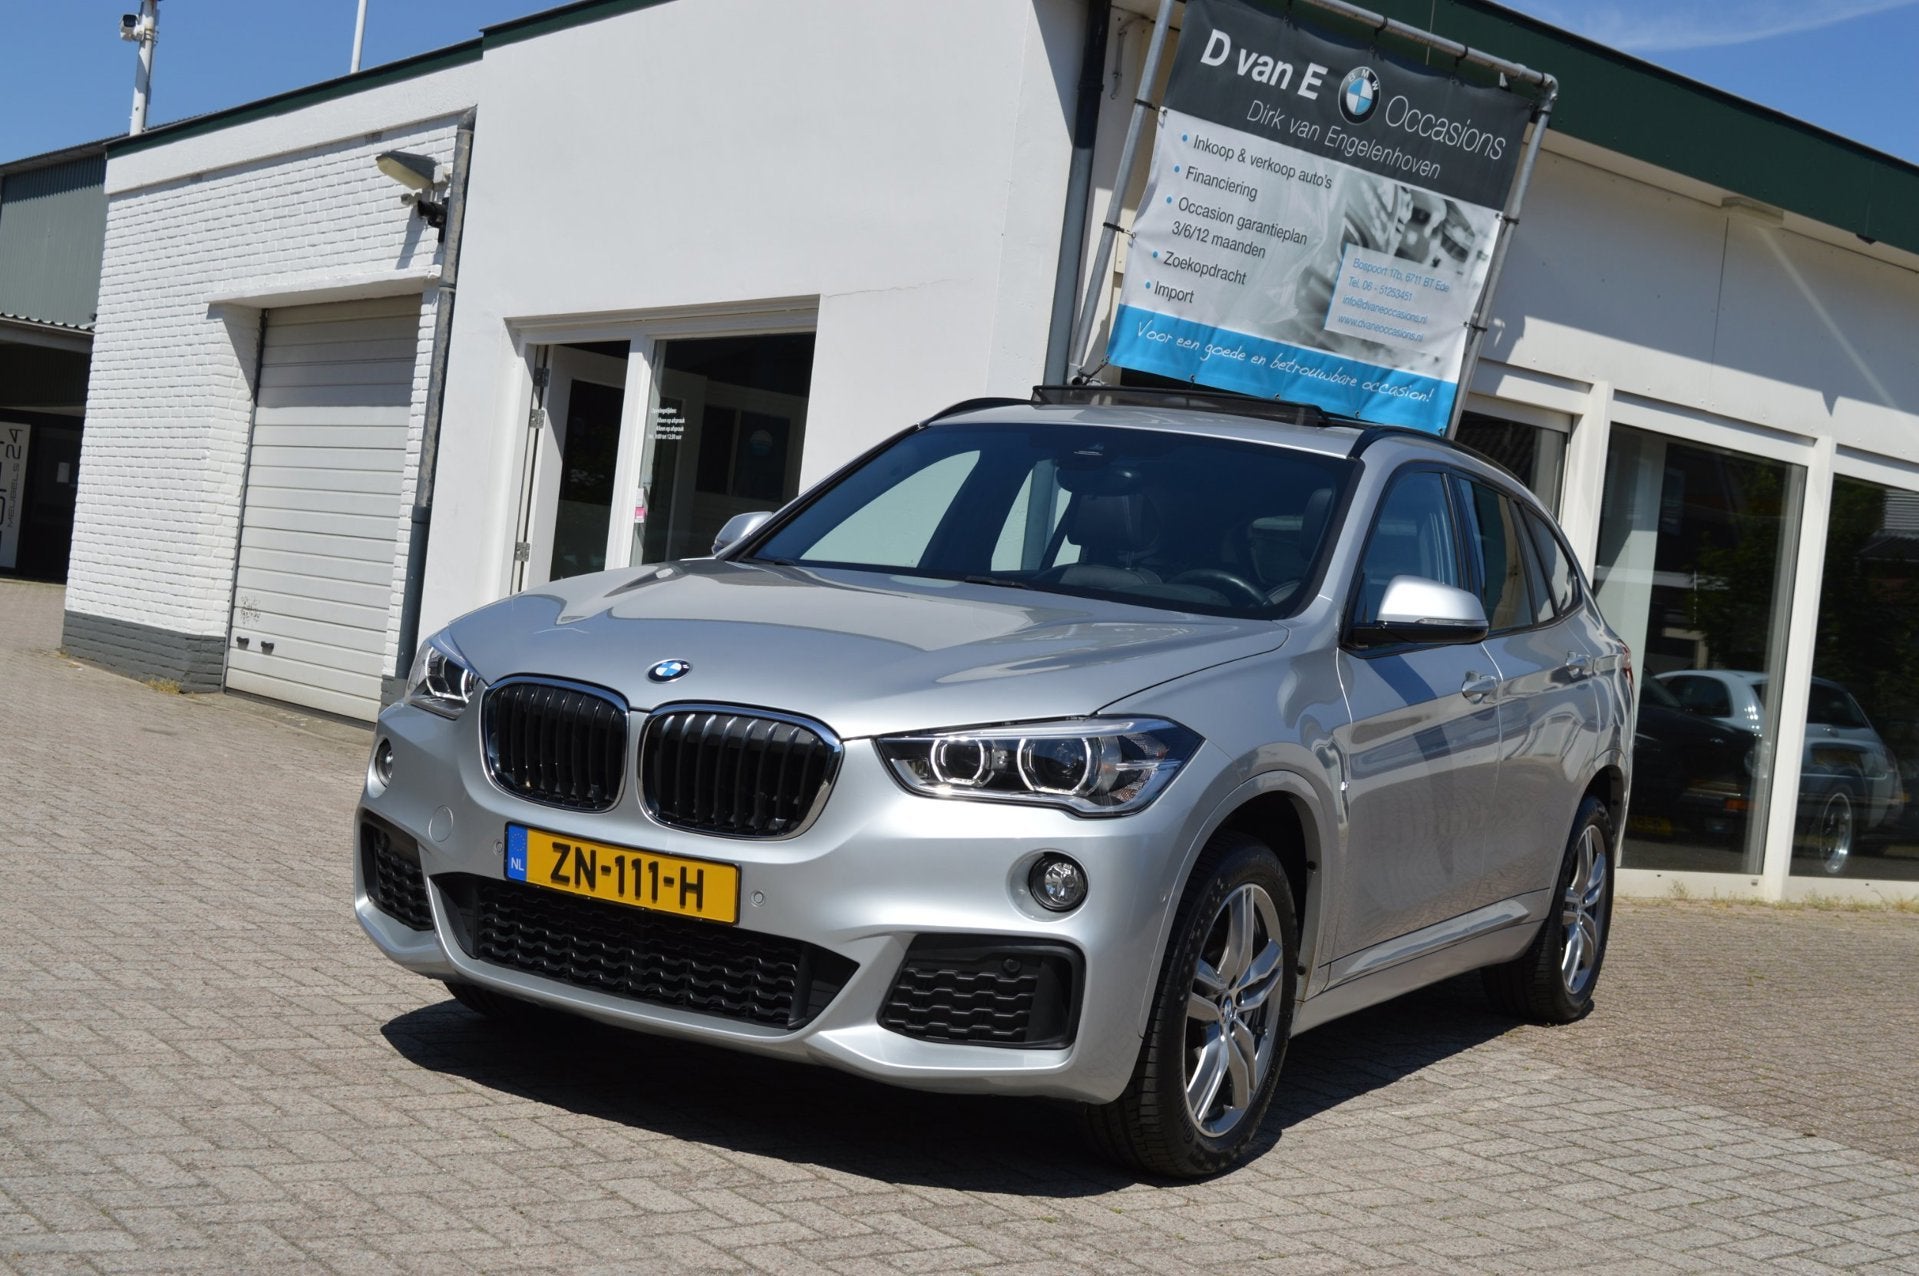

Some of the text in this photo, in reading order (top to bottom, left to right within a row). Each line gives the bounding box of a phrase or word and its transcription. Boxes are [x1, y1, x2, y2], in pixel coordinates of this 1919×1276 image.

[1200, 29, 1328, 100] D van E
[1246, 99, 1441, 179] Dirk van Engelenhoven
[1385, 95, 1506, 160] Occasions
[1185, 165, 1258, 202] Financiering
[1193, 134, 1333, 189] Inkoop & verkoop auto's
[1171, 220, 1266, 259] 3/6/12 maanden
[1178, 196, 1308, 246] Occasion garantieplan
[1153, 280, 1195, 304] Import
[1163, 250, 1248, 285] Zoekopdracht
[1138, 319, 1435, 402] Voor een goede en betrouwbare occasion!
[5, 428, 24, 529] MEUBELS 24
[511, 856, 525, 872] NL
[550, 841, 704, 911] ZN-111-H
